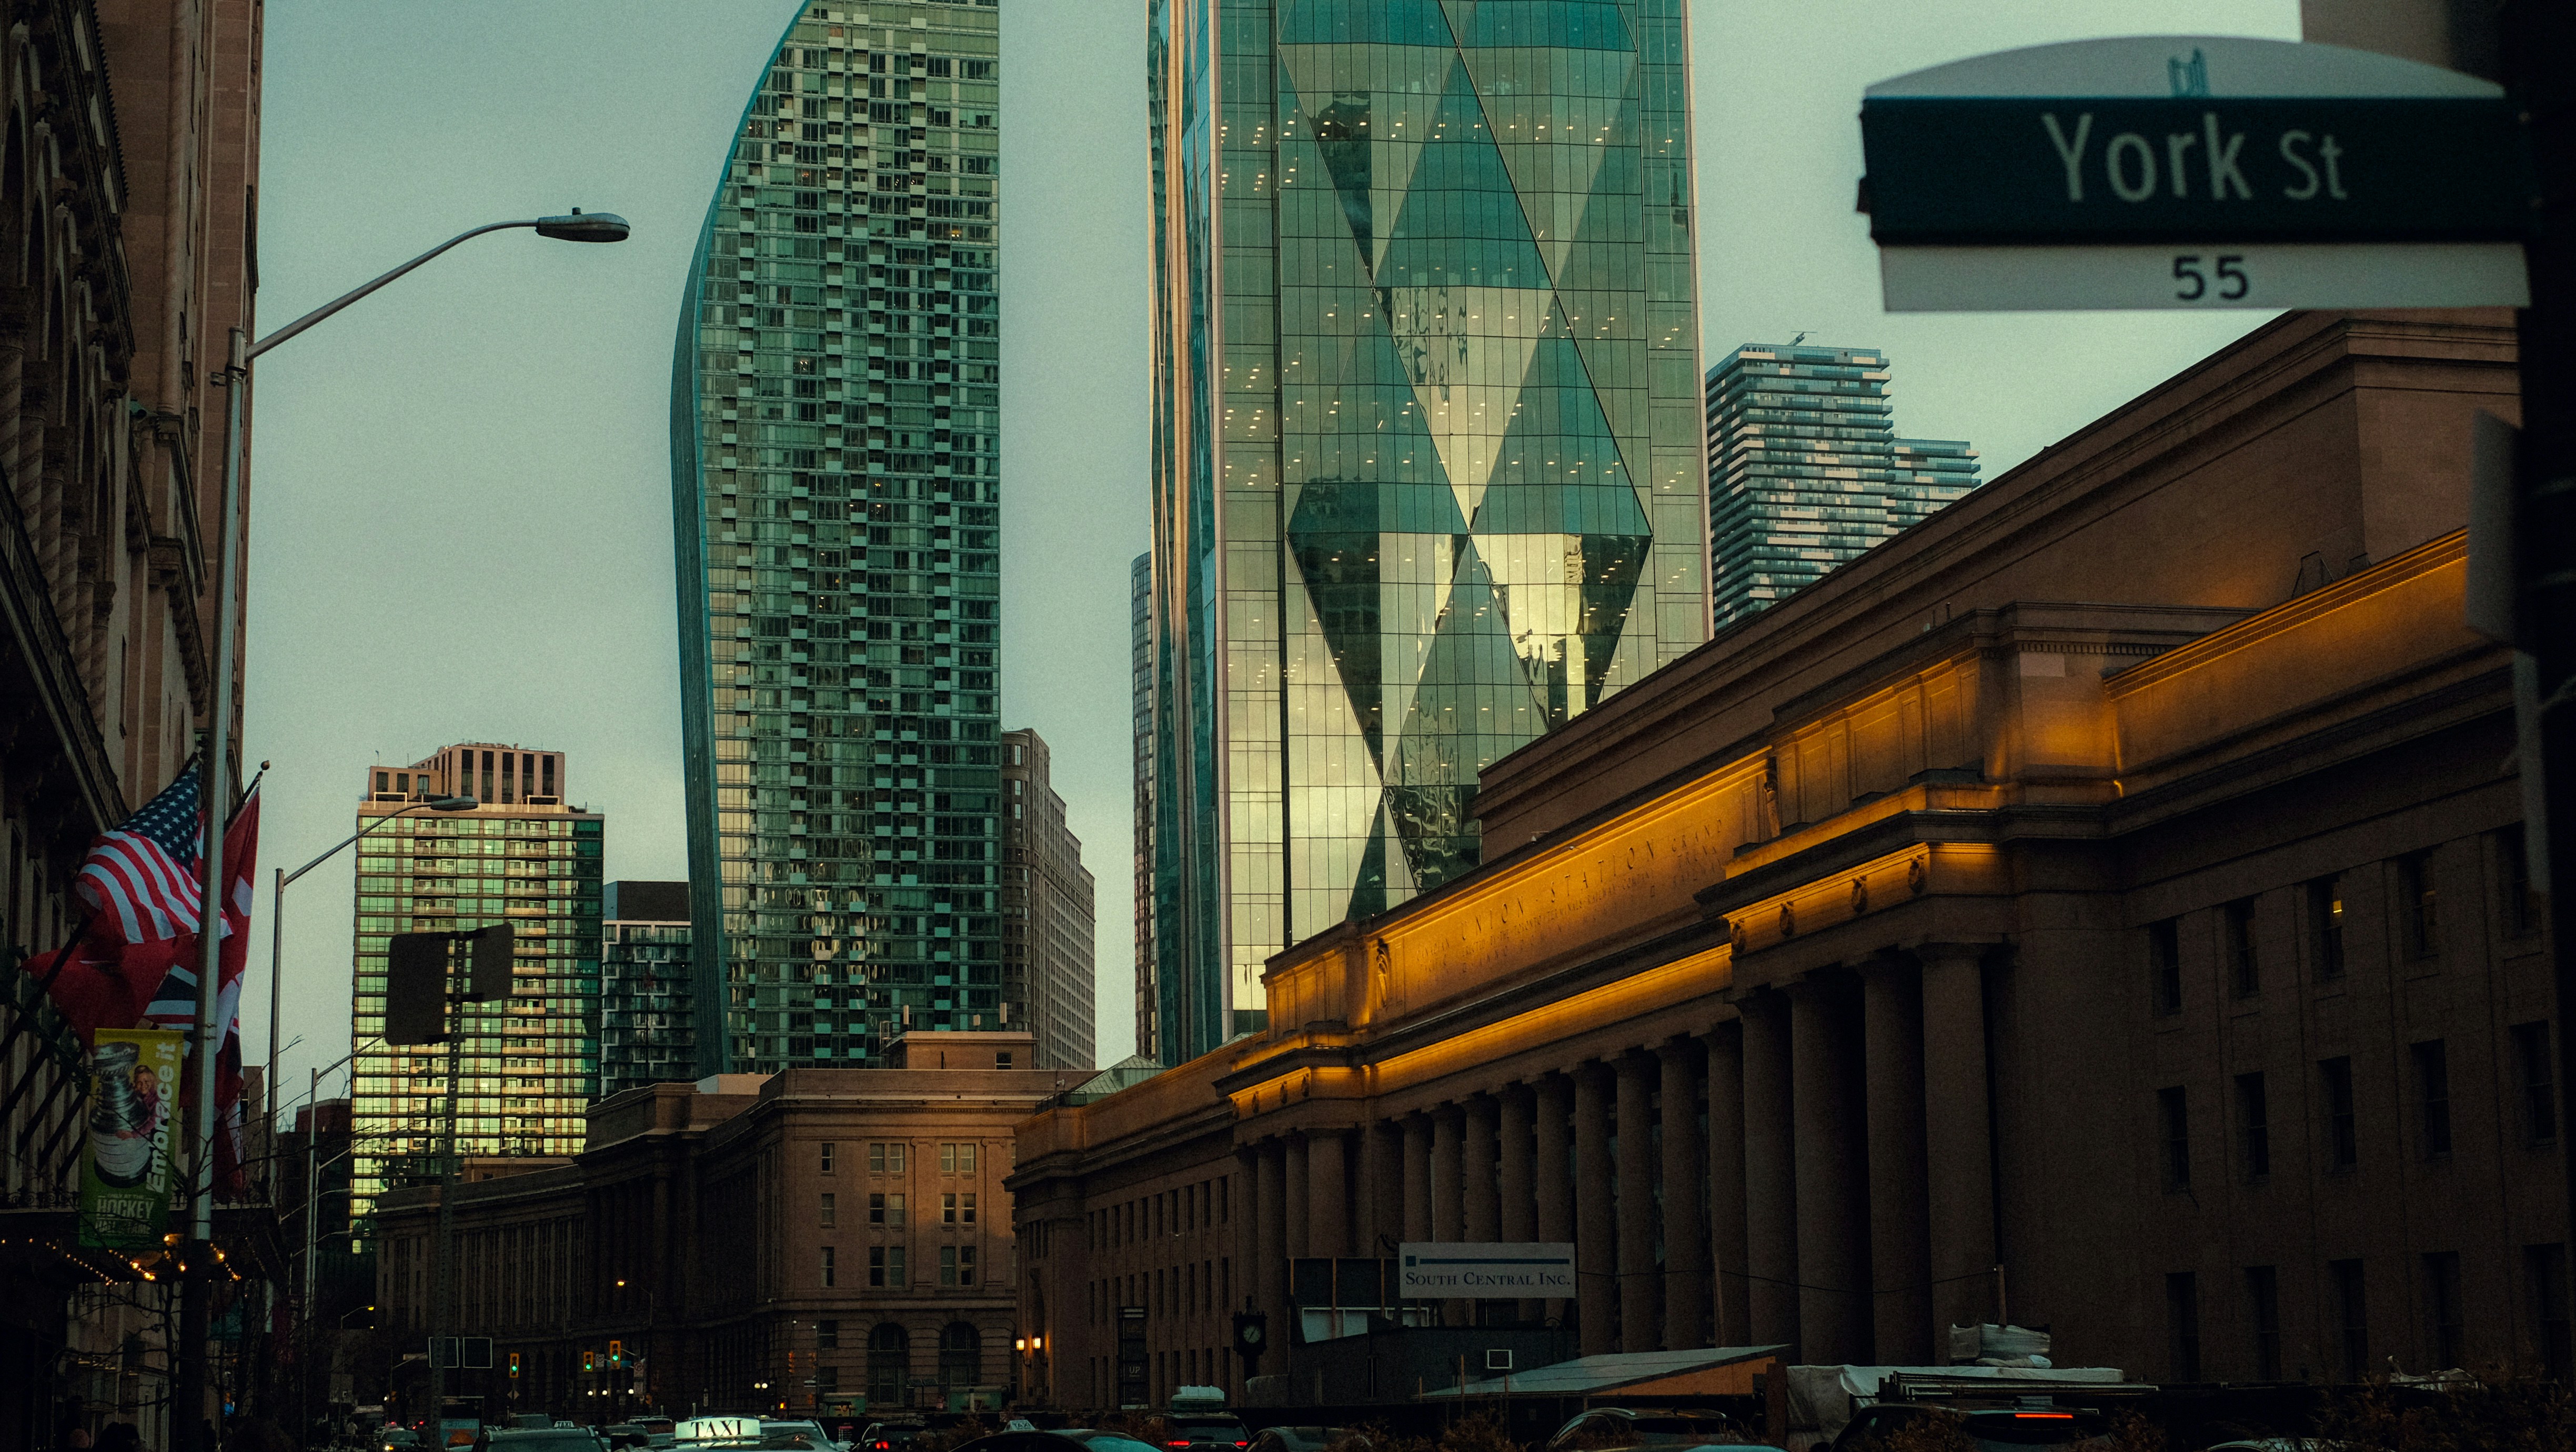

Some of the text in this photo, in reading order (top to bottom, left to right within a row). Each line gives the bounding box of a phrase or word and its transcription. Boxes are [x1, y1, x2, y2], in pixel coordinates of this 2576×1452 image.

[2040, 111, 2349, 203] York St
[2173, 256, 2248, 300] 55
[1461, 895, 1524, 941] UNION
[1551, 837, 1654, 903] STATION
[146, 1042, 177, 1193] Embrace it
[96, 1198, 155, 1219] HOCKEY
[1129, 1365, 1141, 1374] UP
[690, 1419, 743, 1437] TAXI
